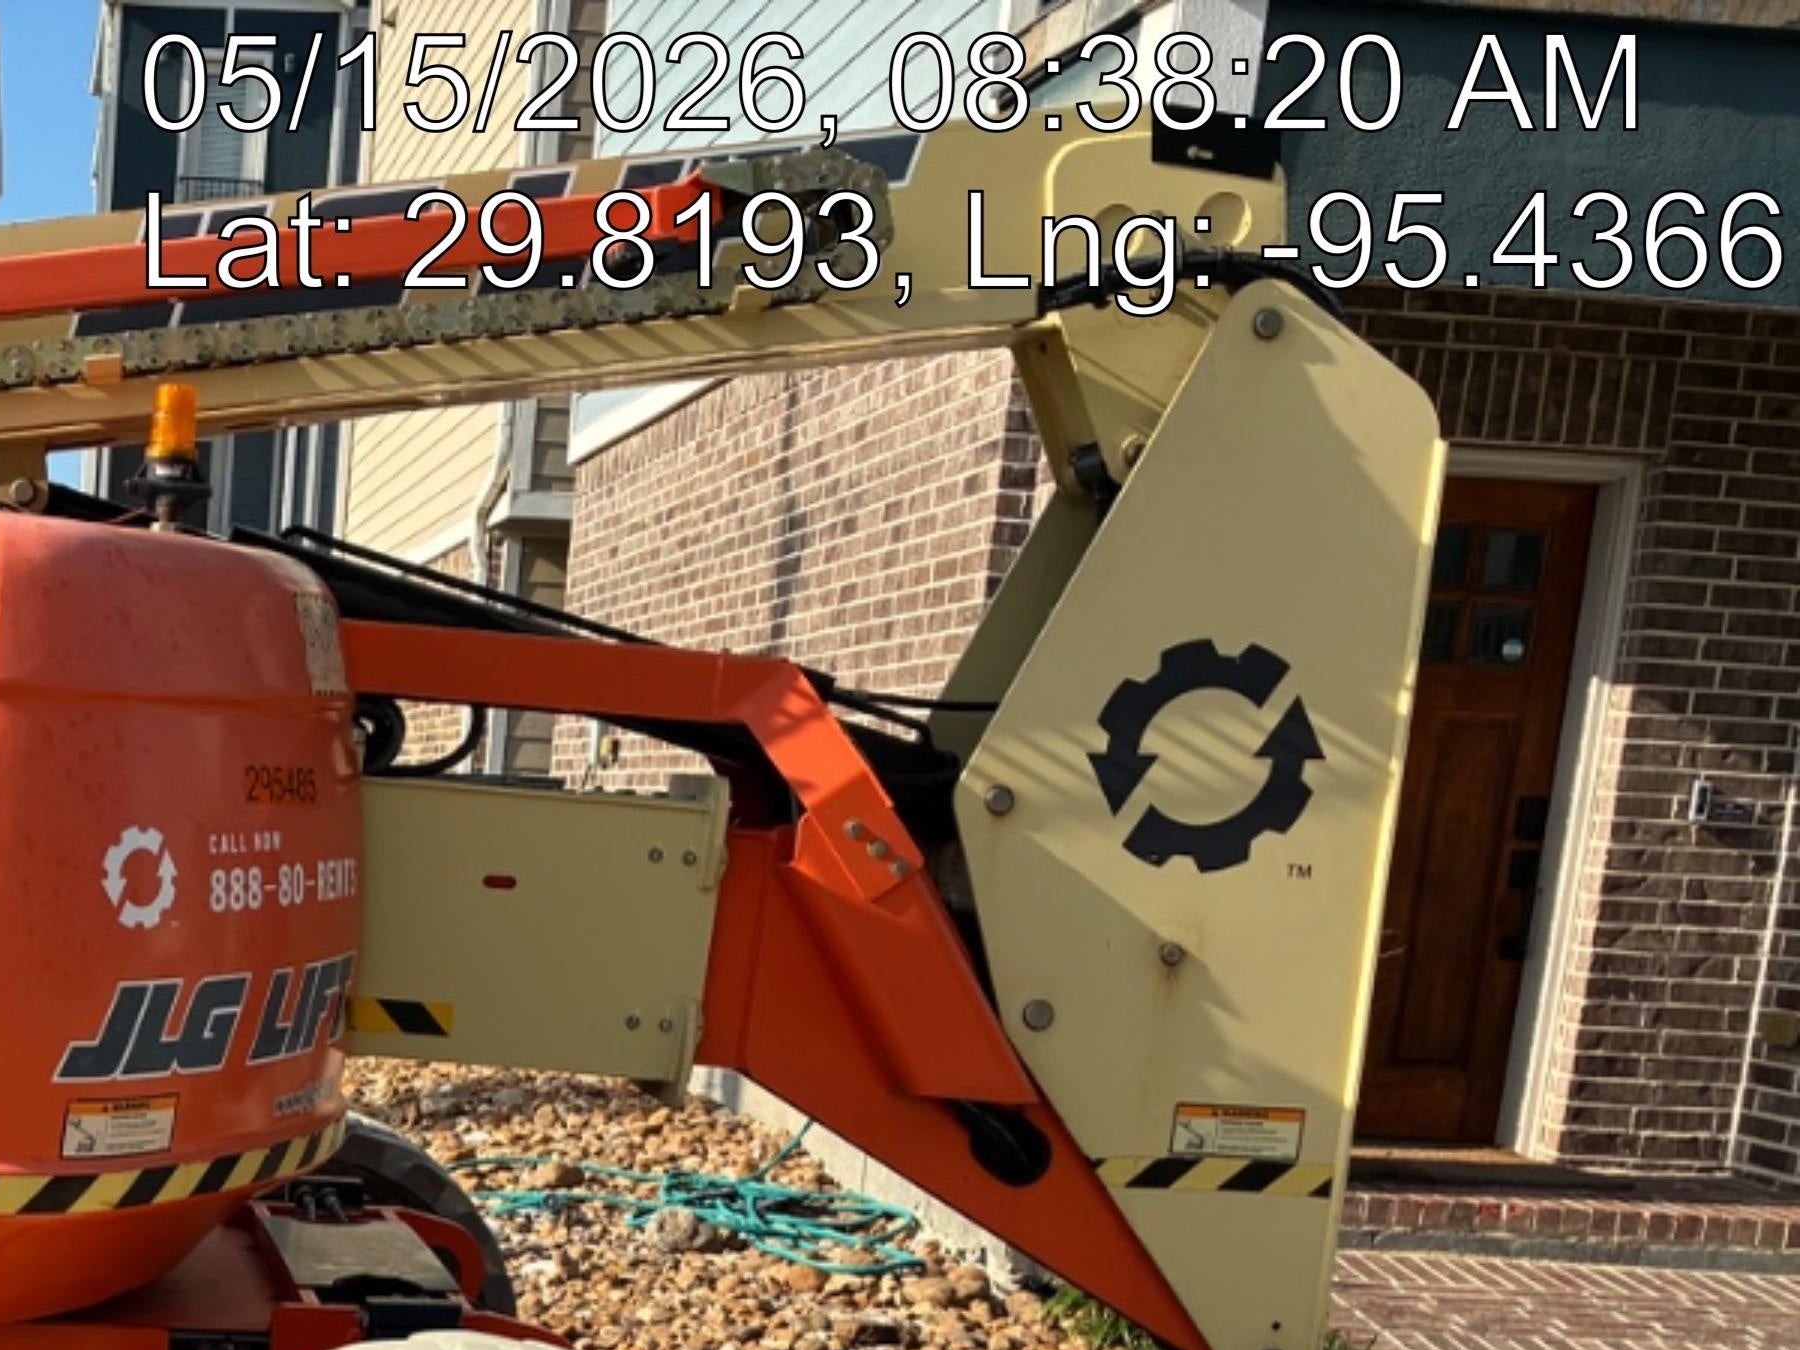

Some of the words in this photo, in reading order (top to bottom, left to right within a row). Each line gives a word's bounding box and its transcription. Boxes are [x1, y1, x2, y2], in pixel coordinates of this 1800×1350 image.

[208, 831, 247, 857] CALL
[253, 829, 282, 853] NOW
[52, 971, 253, 1084] JLG
